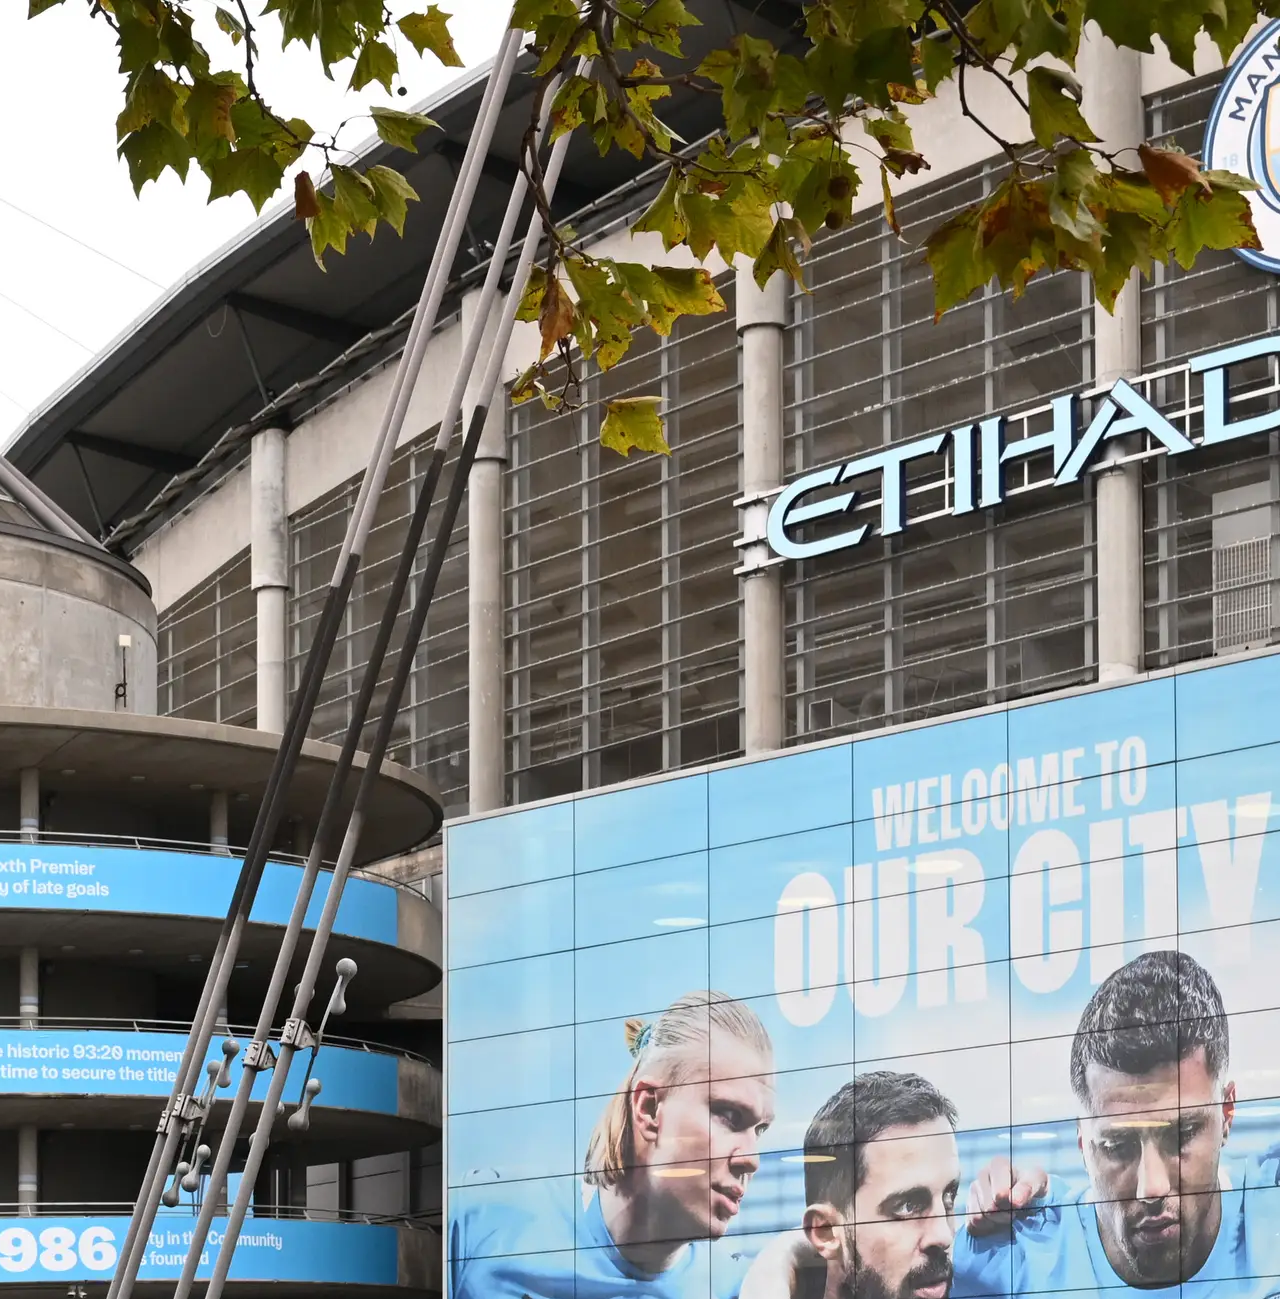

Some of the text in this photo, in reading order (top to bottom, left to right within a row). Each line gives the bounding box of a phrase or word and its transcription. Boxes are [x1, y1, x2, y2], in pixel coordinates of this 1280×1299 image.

[871, 735, 1148, 853] WELCOME TO
[30, 858, 96, 876] Premier
[12, 879, 31, 894] of
[32, 879, 64, 895] late
[66, 881, 110, 898] goals
[773, 790, 1273, 1029] OUR CITY
[6, 1043, 70, 1060] historic
[73, 1044, 123, 1061] 93:20
[0, 1064, 38, 1080] time
[41, 1065, 59, 1080] to
[62, 1066, 116, 1081] secure
[118, 1065, 145, 1082] the
[147, 1066, 178, 1083] title
[167, 1231, 180, 1245] in
